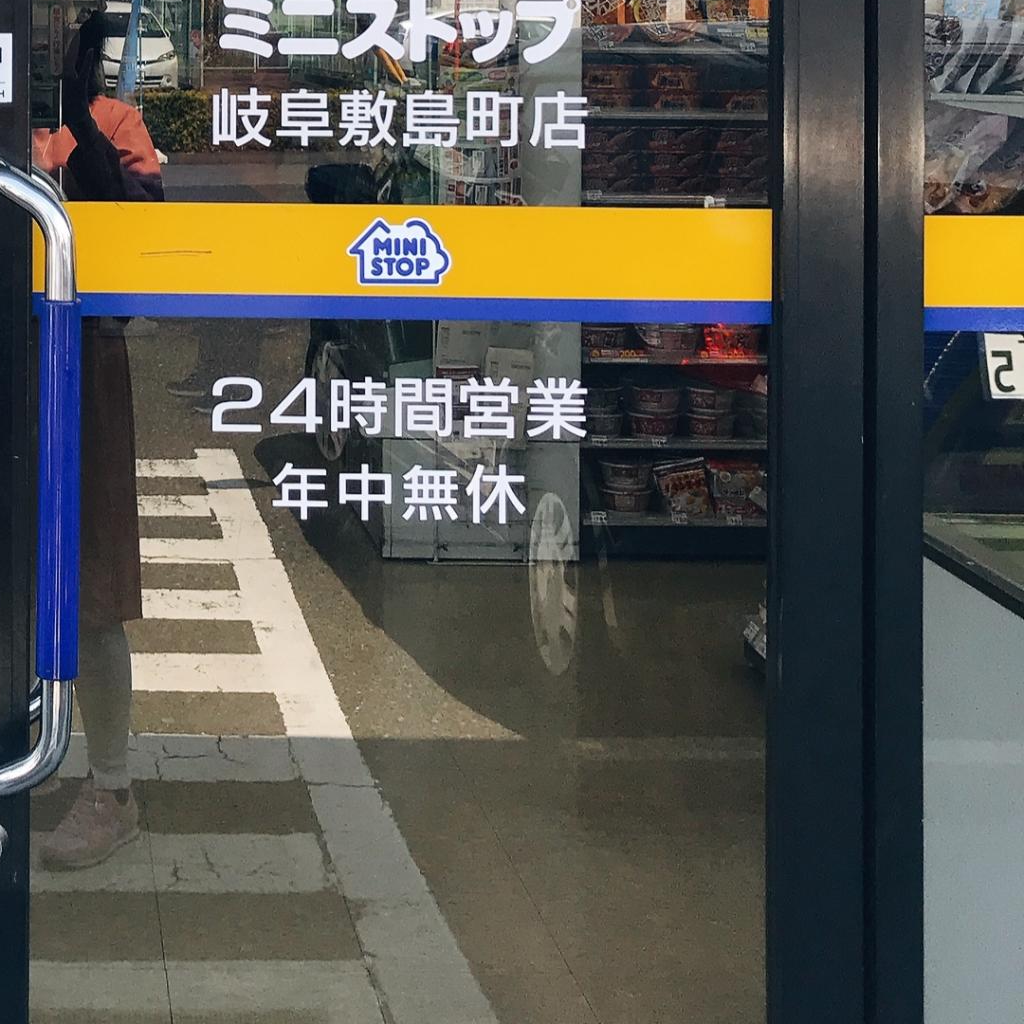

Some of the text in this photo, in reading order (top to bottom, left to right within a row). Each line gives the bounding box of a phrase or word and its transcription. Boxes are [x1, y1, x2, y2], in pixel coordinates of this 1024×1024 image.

[212, 89, 588, 150] 岐阜敷島町店
[371, 257, 430, 277] STOP
[373, 237, 426, 256] MINI
[212, 376, 590, 440] 24時間営業
[272, 462, 527, 524] 年中無休
